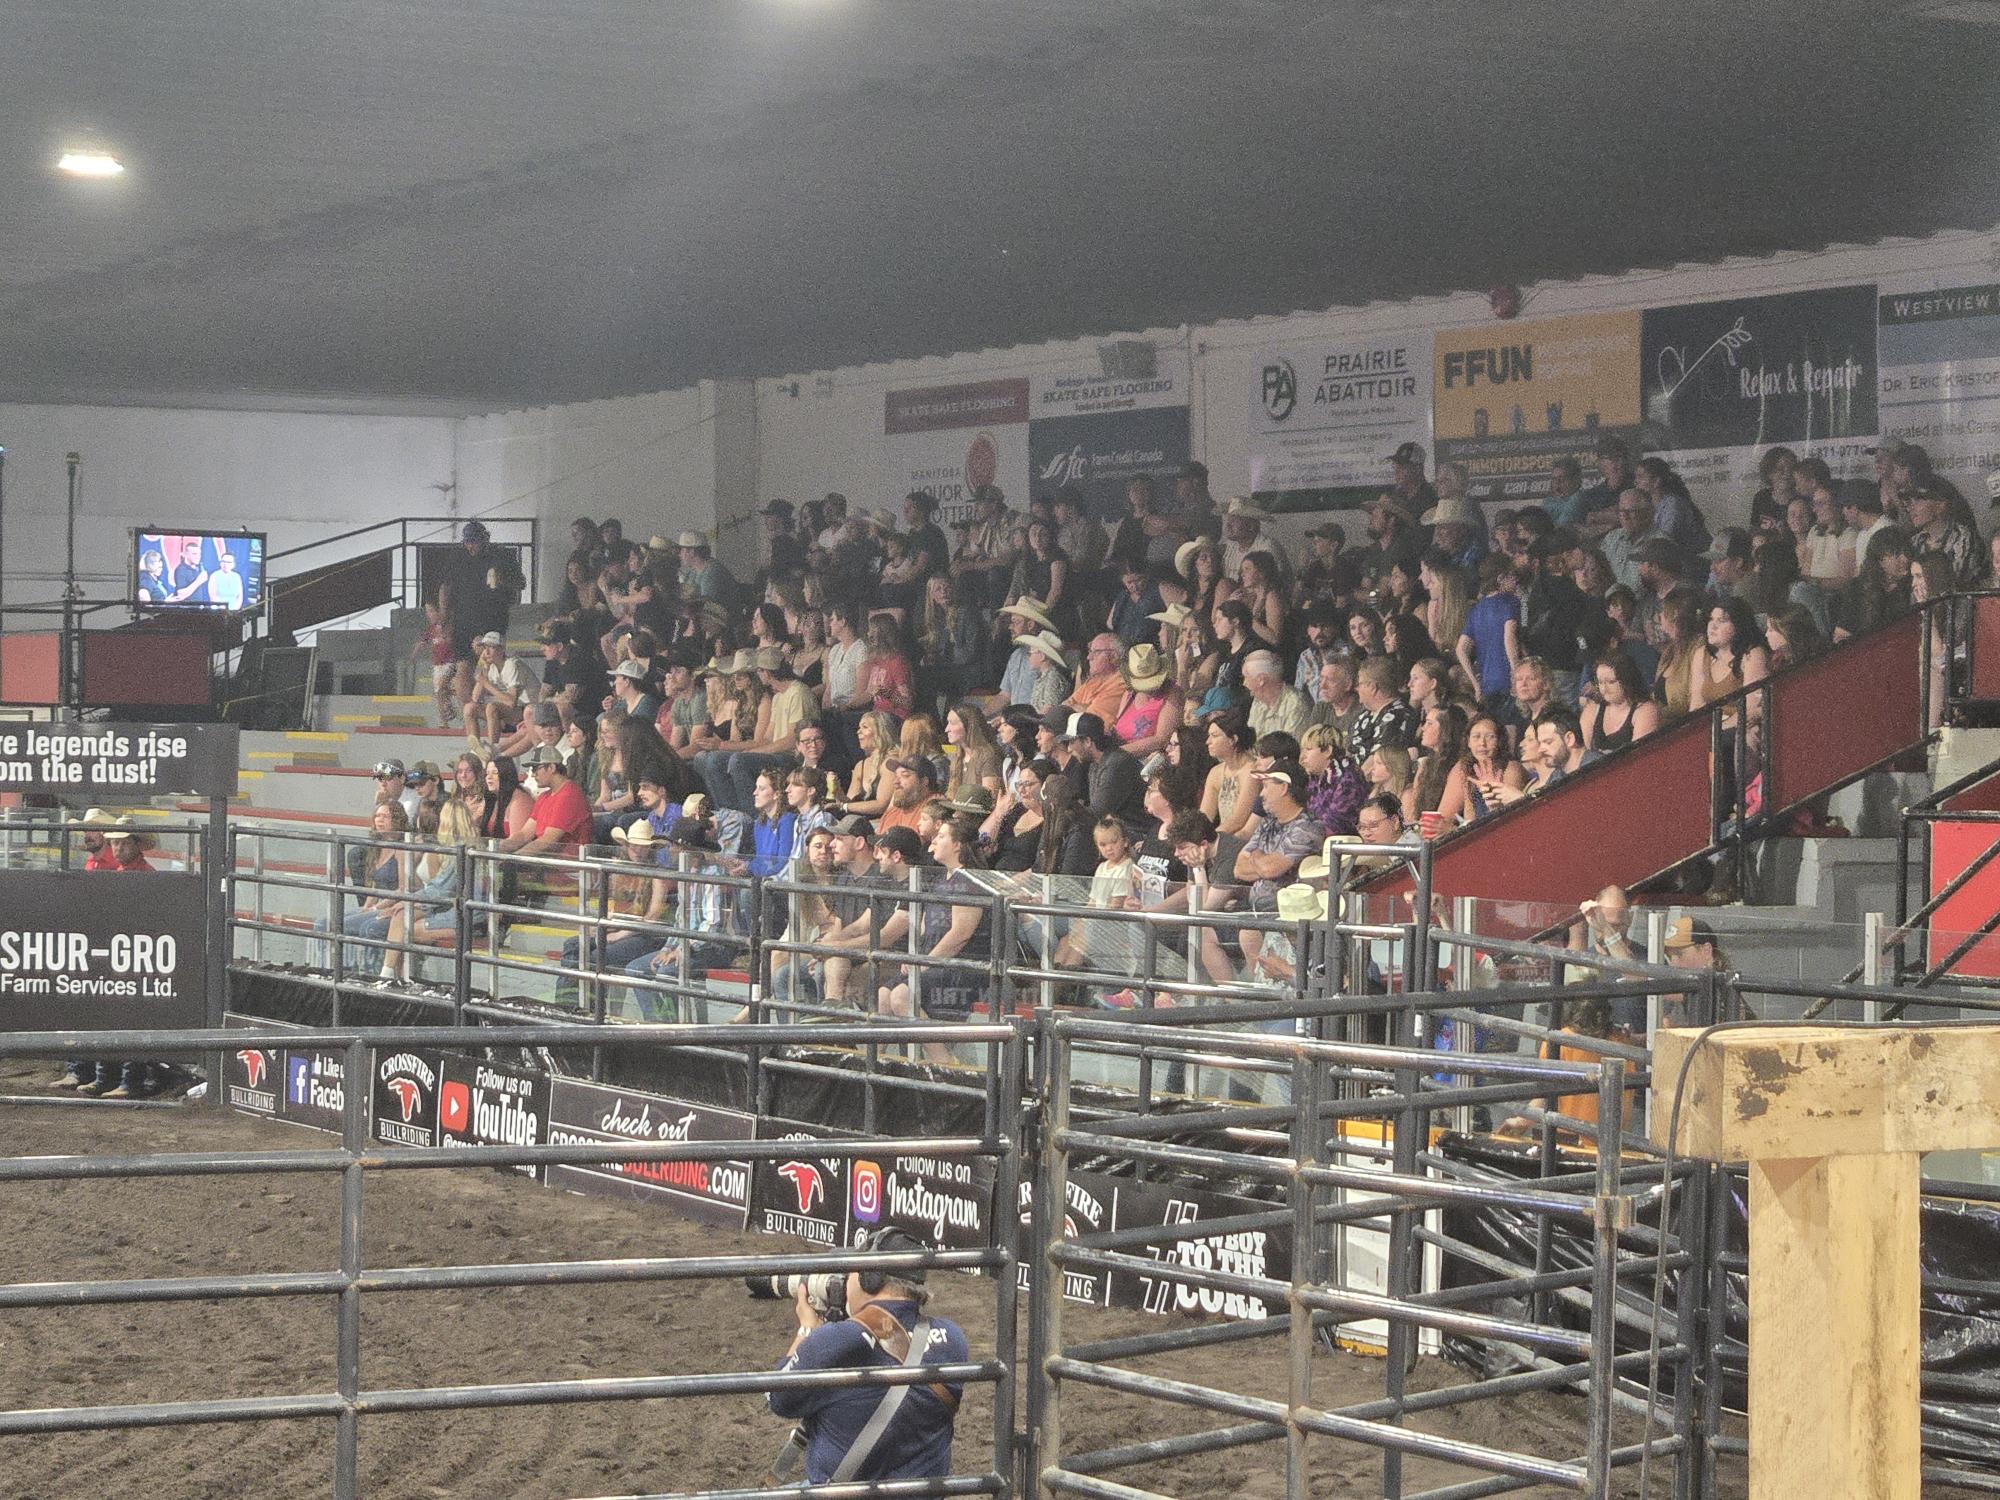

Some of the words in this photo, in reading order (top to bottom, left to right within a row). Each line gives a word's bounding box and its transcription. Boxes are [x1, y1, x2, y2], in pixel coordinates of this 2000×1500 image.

[1894, 292, 1990, 317] WESTVIEW
[1324, 349, 1407, 374] PRAIRIE
[1444, 344, 1533, 389] FFUN
[1313, 377, 1417, 405] ABATTOIR
[1740, 365, 1782, 398] Relax
[1786, 362, 1797, 393] &
[1803, 359, 1863, 397] Repair
[1910, 375, 1939, 390] ERIC
[27, 730, 129, 762] legends
[138, 732, 187, 758] rise
[42, 758, 83, 783] the
[91, 758, 157, 784] dust!
[0, 931, 176, 974] SHUR-GRO
[1, 973, 50, 993] Farm
[56, 974, 137, 995] Services
[142, 976, 178, 997] Ltd.
[323, 1056, 340, 1078] Like
[381, 1053, 435, 1092] CROSSFIRE
[475, 1066, 505, 1093] Follow
[506, 1076, 518, 1095] us
[519, 1079, 533, 1097] on
[230, 1088, 275, 1110] BULLRIDING
[473, 1087, 538, 1147] YouTube
[601, 1098, 652, 1137] check
[658, 1110, 696, 1141] out
[380, 1121, 430, 1147] BULLRIDING
[938, 1160, 953, 1180] us
[955, 1163, 971, 1184] on
[887, 1171, 980, 1241] Instagram
[766, 1213, 836, 1242] BULLRIDING
[1176, 1241, 1213, 1271] TO
[1217, 1248, 1266, 1280] THE
